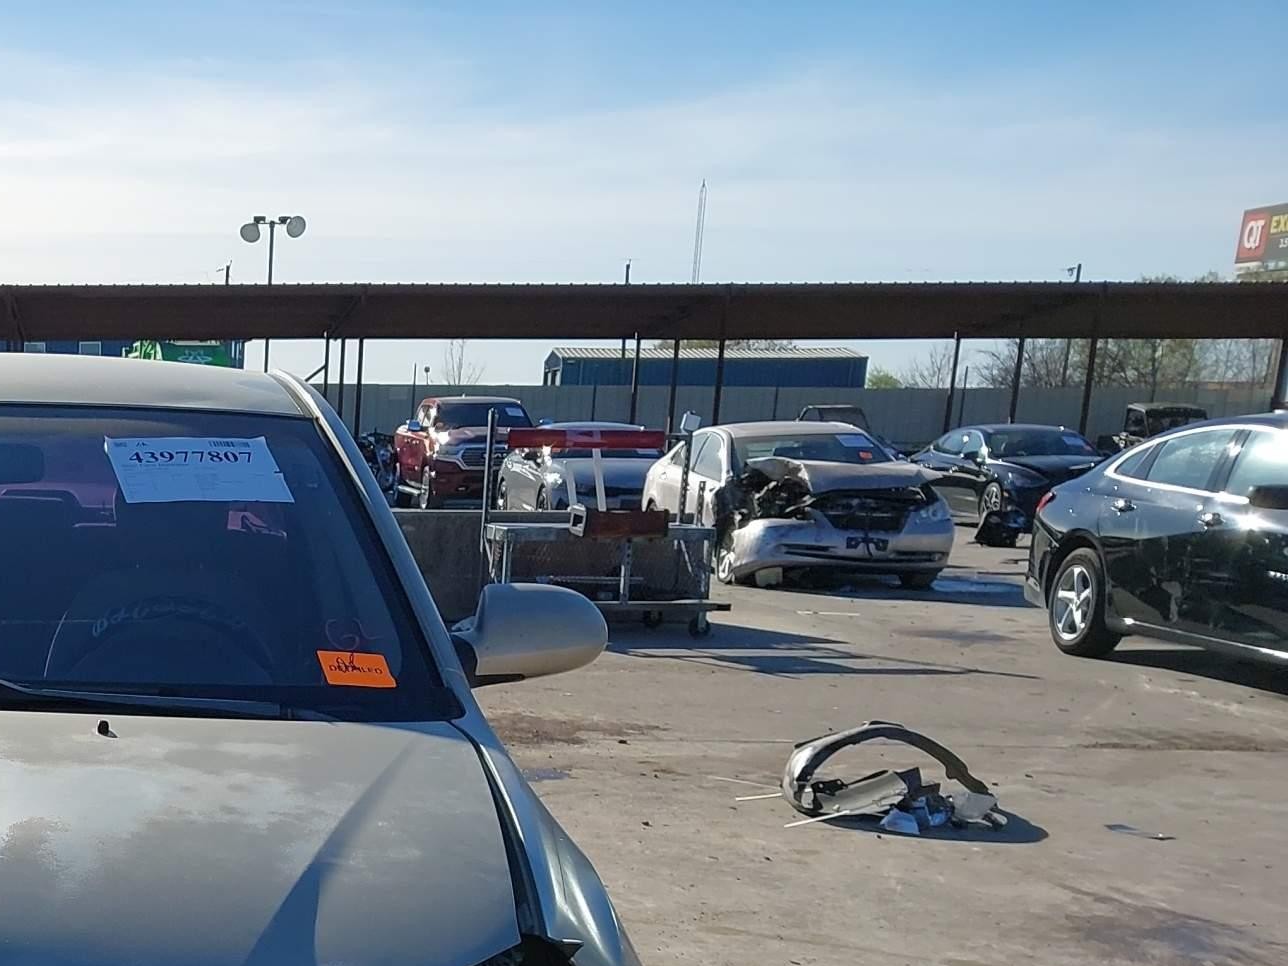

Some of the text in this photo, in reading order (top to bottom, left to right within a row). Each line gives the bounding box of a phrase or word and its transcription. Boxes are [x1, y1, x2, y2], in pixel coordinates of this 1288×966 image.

[1244, 219, 1265, 249] QT
[1270, 214, 1288, 234] EX
[128, 450, 252, 464] 43977807
